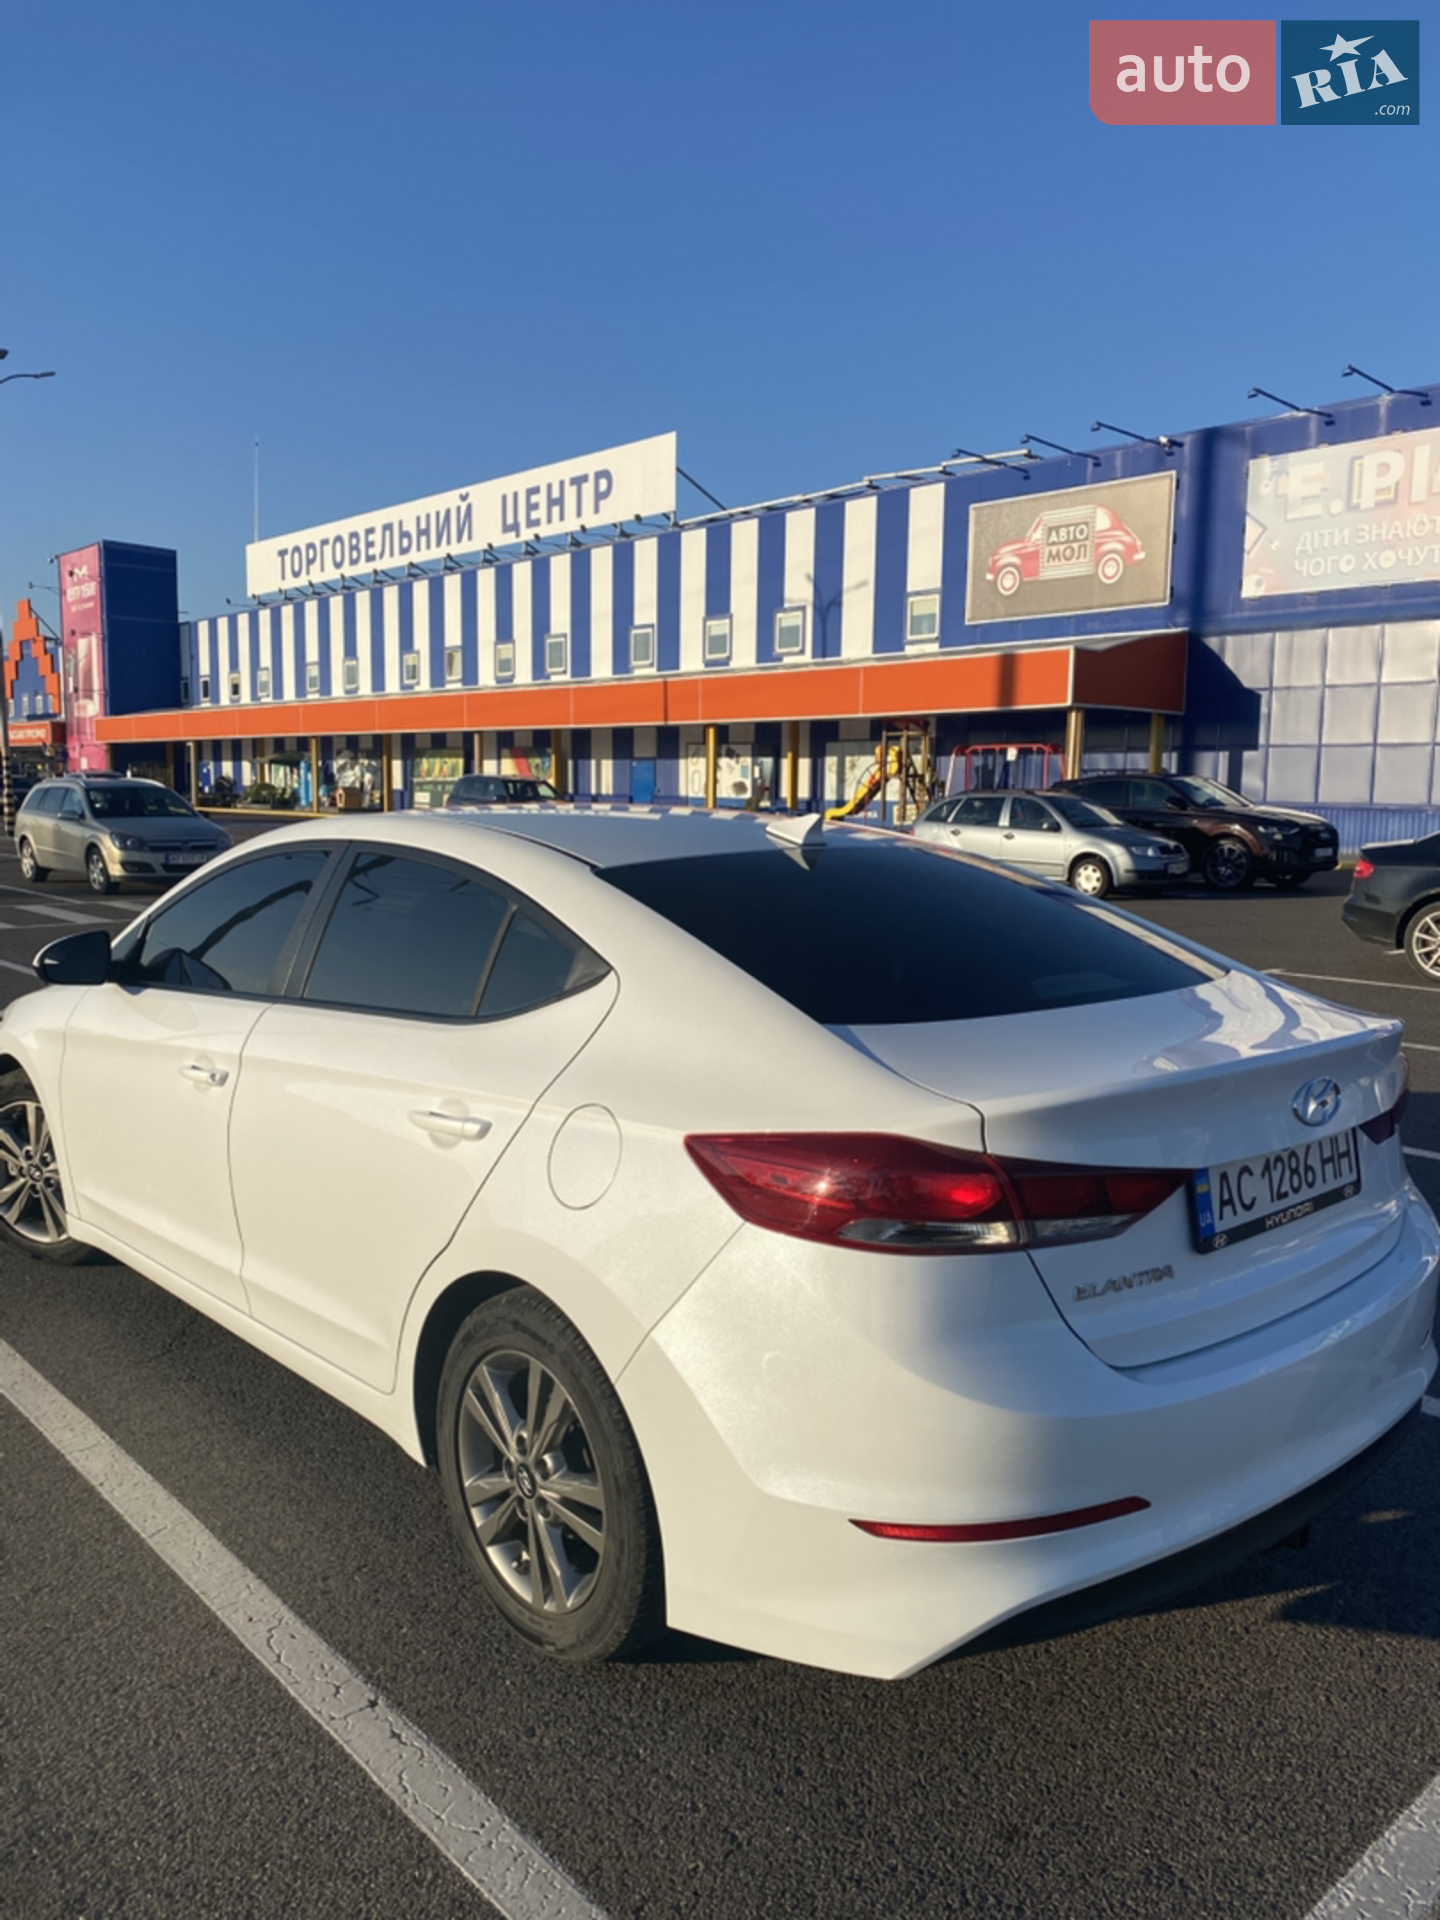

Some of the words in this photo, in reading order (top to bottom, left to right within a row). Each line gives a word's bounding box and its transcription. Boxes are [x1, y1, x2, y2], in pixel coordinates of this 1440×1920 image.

[1286, 443, 1440, 521] Е.РІ
[277, 491, 474, 581] ТОРГОВЕЛЬНИЙ
[500, 468, 615, 539] ЦЕНТР
[1047, 523, 1089, 545] АВТО
[1045, 543, 1088, 565] МОЛ
[1295, 526, 1350, 557] ДІТИ
[1294, 551, 1356, 577] ЧОГО
[1218, 1164, 1258, 1222] AC
[1260, 1144, 1317, 1204] 1286
[1318, 1130, 1354, 1186] HH
[1199, 1212, 1214, 1228] UA
[1264, 1201, 1315, 1230] HYUNDAI
[1072, 1263, 1175, 1302] ELANTRA
